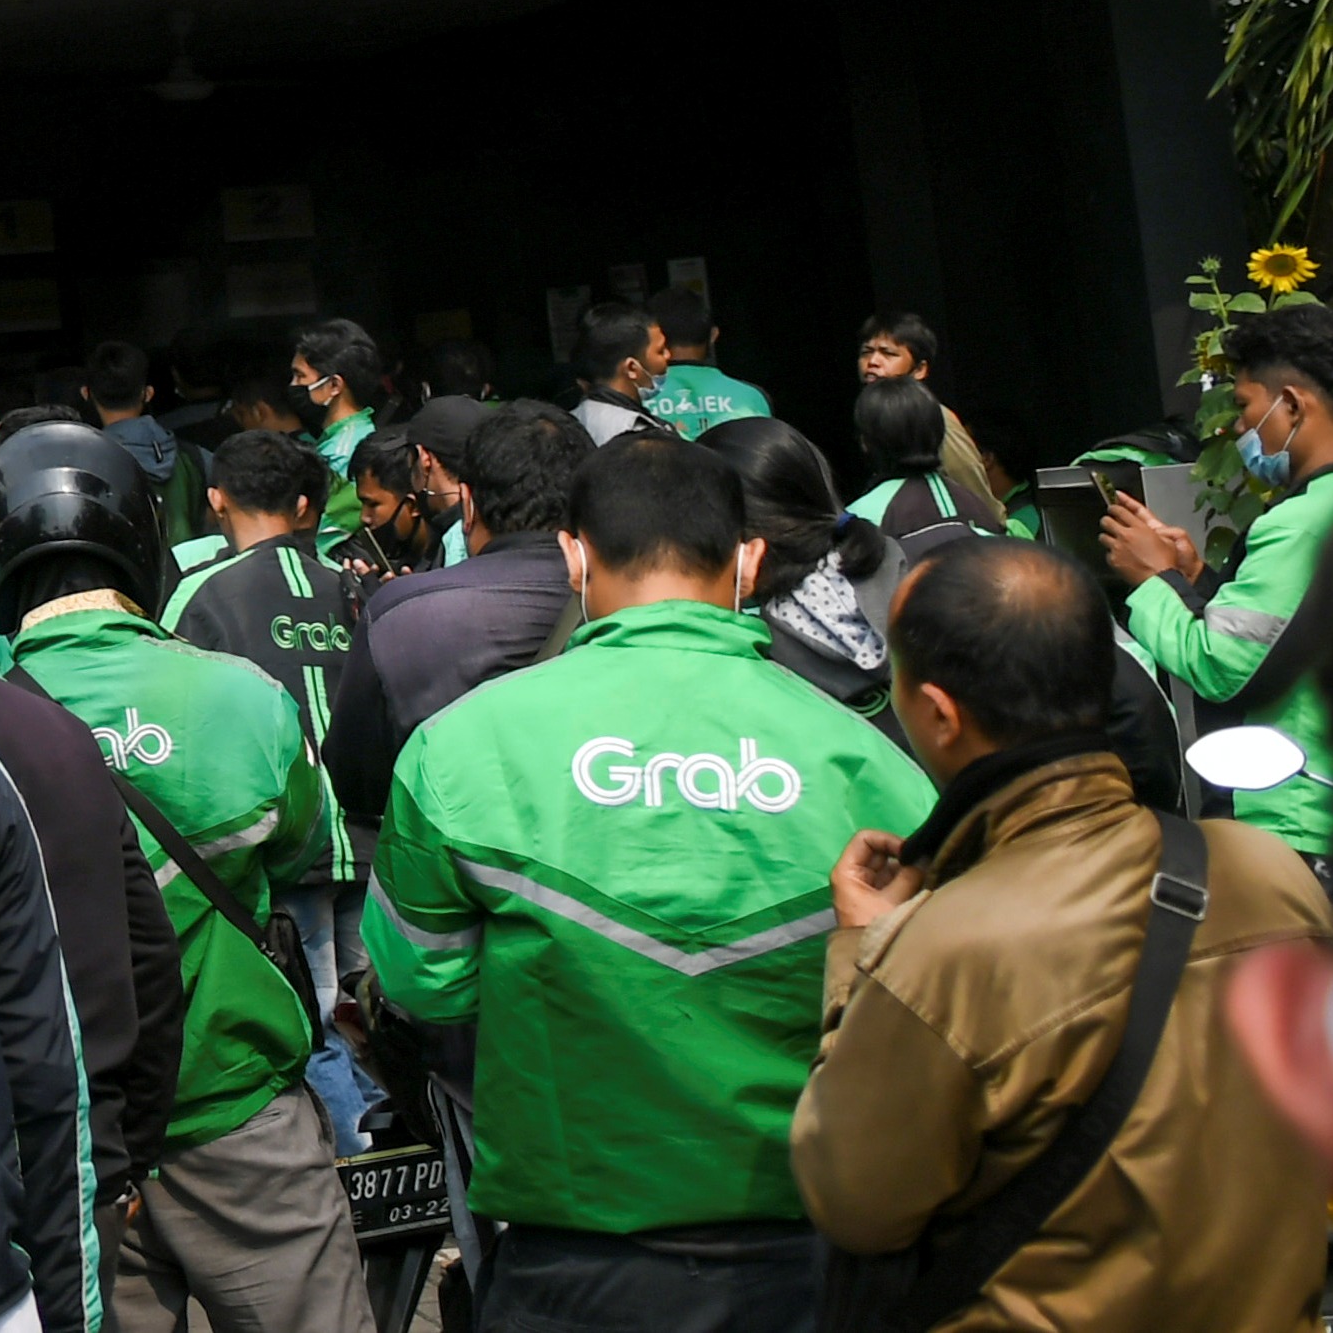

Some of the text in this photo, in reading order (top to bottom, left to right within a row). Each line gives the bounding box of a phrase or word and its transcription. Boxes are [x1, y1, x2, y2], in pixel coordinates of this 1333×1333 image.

[270, 612, 353, 652] Grab
[90, 706, 173, 772] ab
[571, 736, 802, 814] Grab
[350, 1165, 409, 1201] 3877
